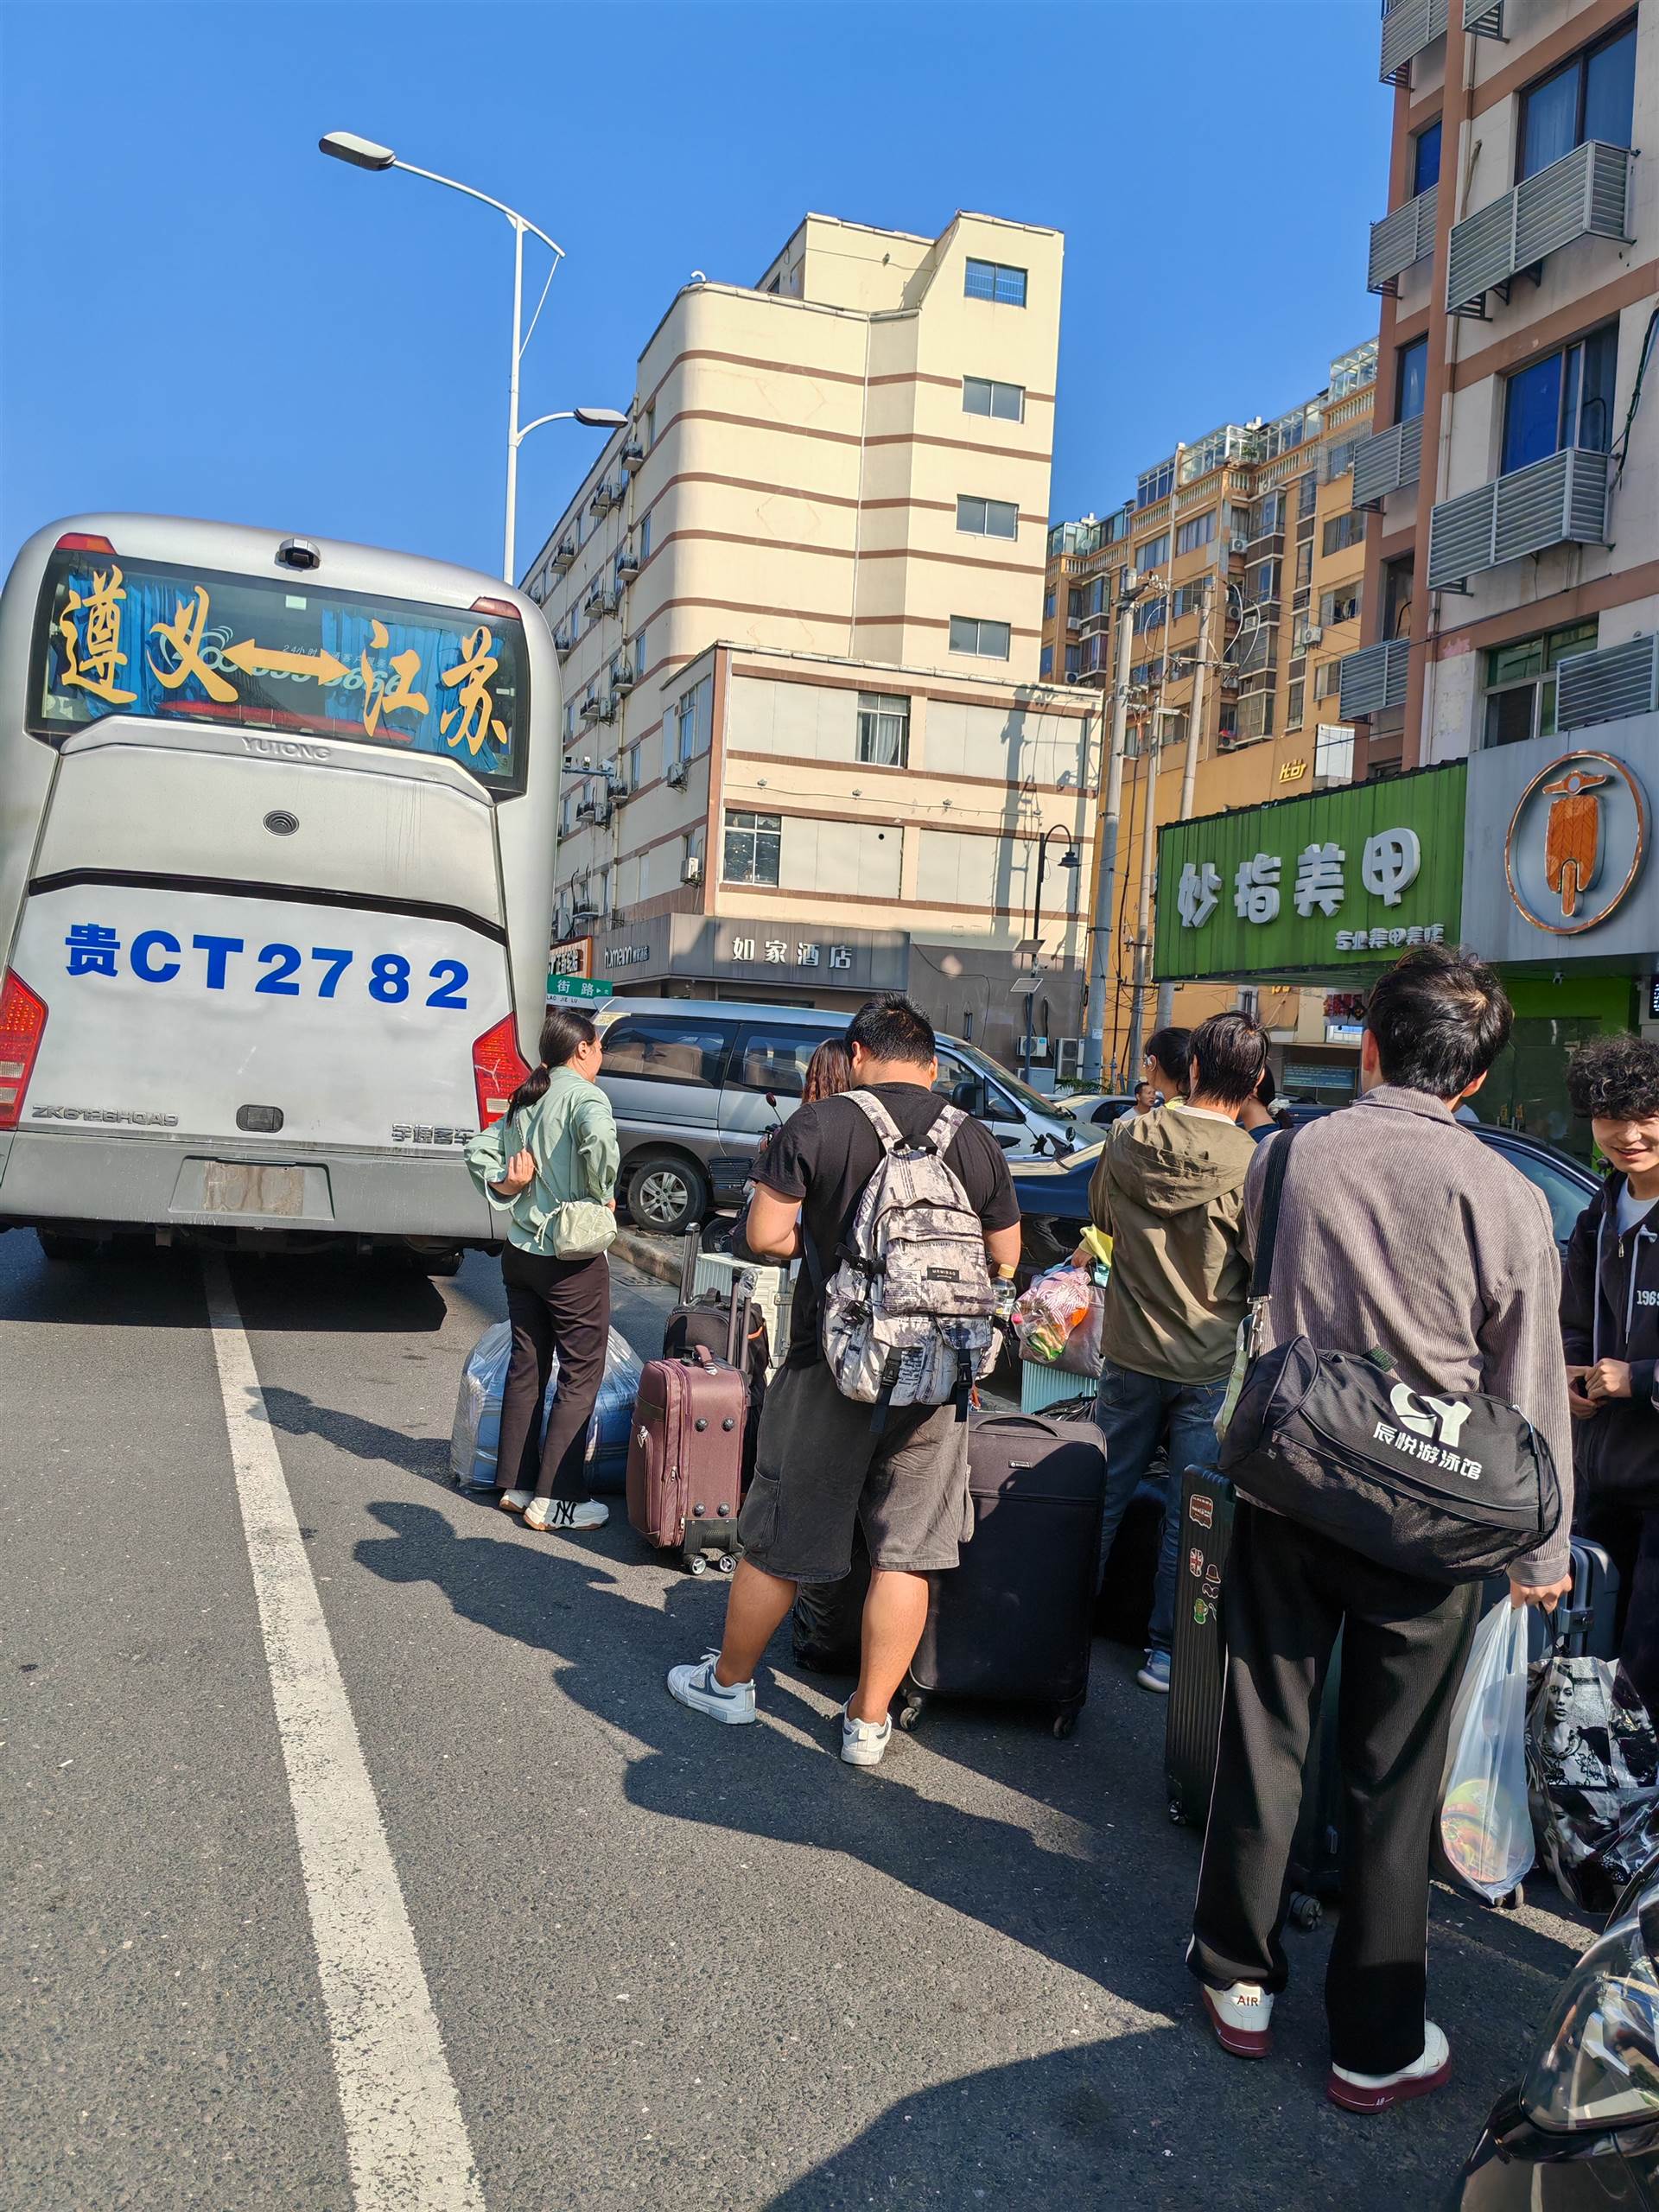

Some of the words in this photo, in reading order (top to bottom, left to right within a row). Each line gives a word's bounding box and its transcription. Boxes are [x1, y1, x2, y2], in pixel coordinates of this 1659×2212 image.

[60, 563, 239, 705] 遵义
[359, 617, 509, 756] 江苏
[242, 736, 331, 760] YUTONG
[1178, 827, 1421, 928] 妙指美甲
[65, 922, 470, 1011] 贵CT2782
[733, 937, 852, 969] 如家酒店
[391, 1123, 474, 1147] 宇通客车
[1373, 1421, 1483, 1480] 辰悦游泳馆
[1236, 1995, 1259, 2007] AIR
